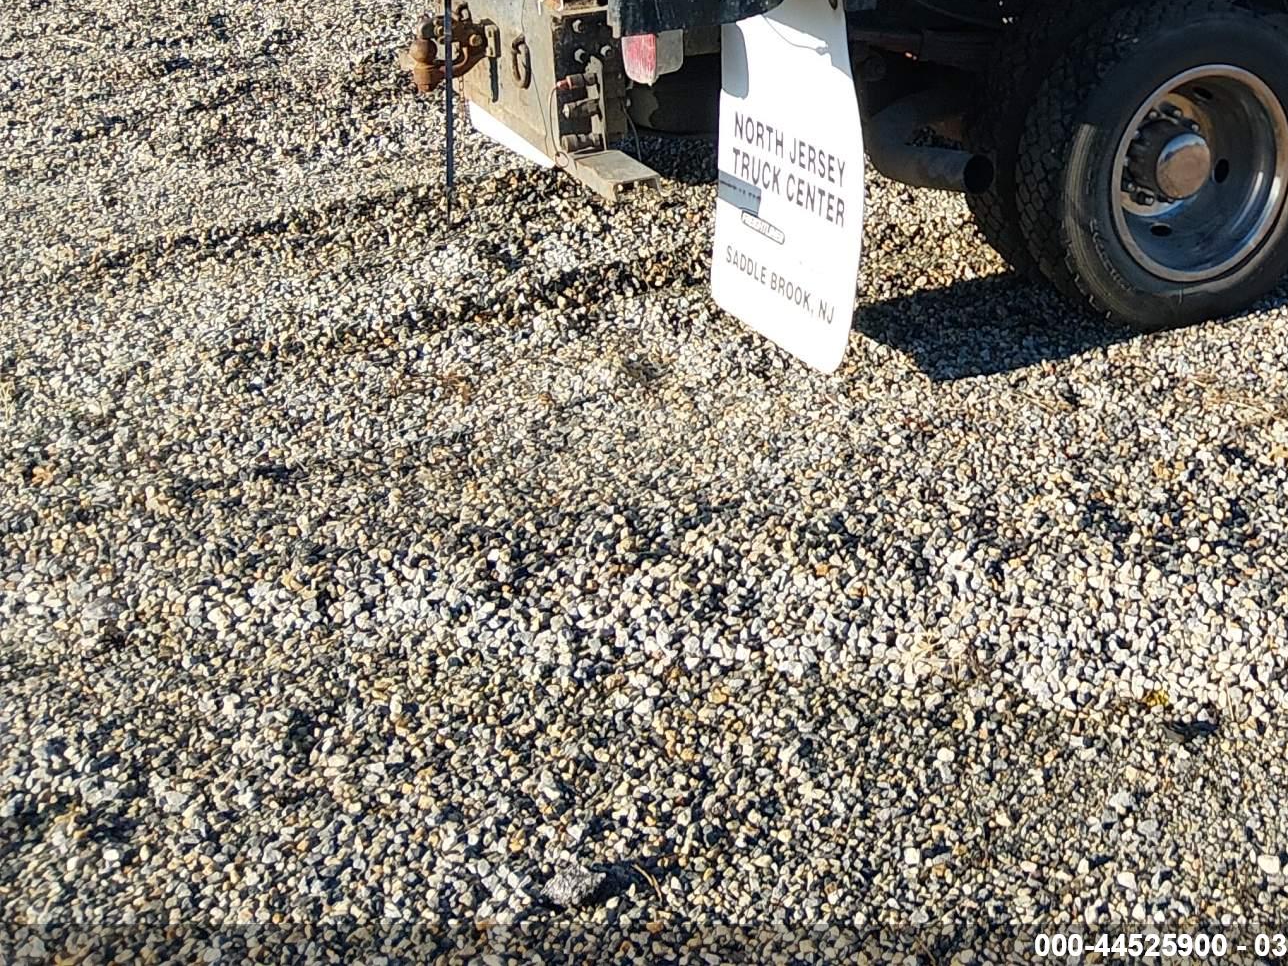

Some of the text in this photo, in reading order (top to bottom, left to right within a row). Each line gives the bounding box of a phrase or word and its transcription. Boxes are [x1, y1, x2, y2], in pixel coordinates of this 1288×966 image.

[732, 146, 782, 195] TRUCK
[786, 173, 845, 227] CENTER
[734, 111, 846, 187] NORTH JERSEY
[726, 245, 835, 325] SADDLE BROOK, NJ
